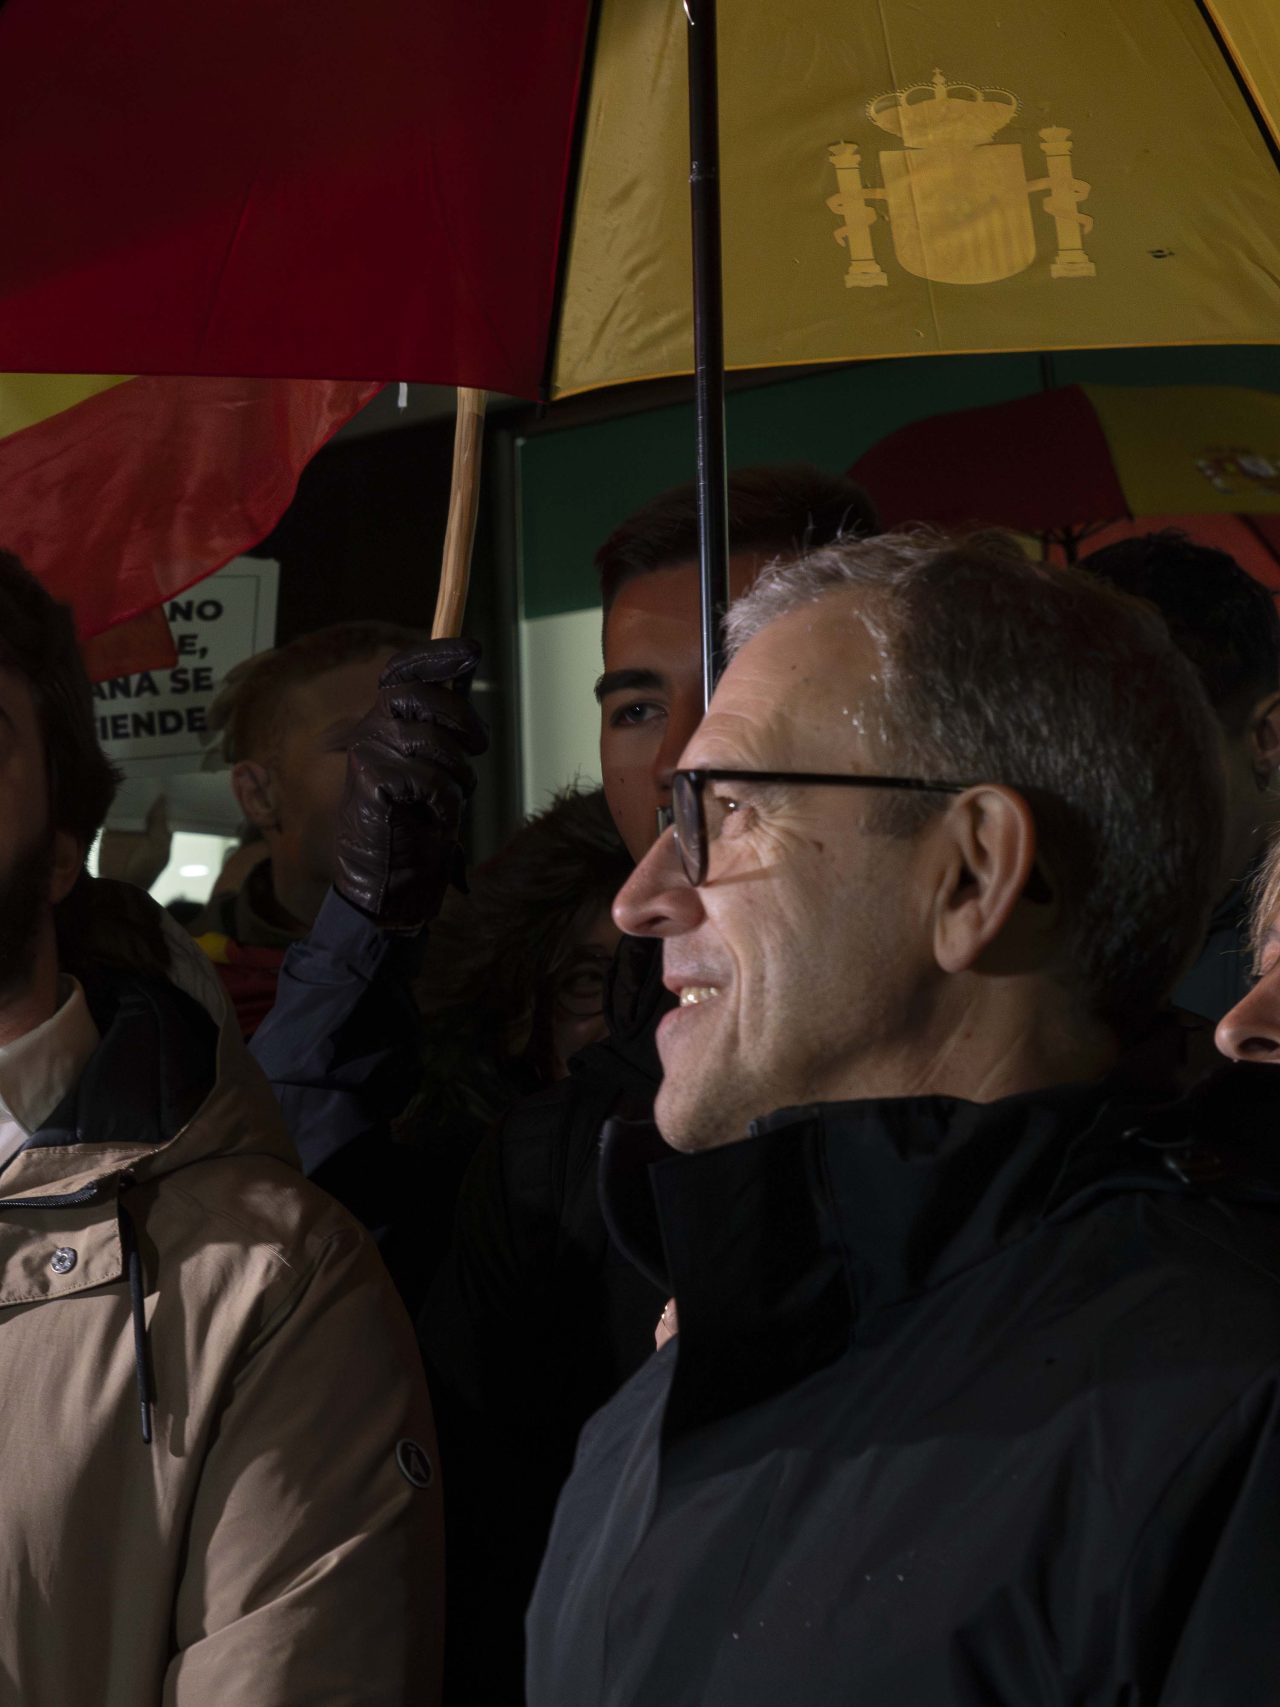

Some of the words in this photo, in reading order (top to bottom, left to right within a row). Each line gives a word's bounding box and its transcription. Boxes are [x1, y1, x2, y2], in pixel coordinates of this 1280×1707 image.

[168, 600, 224, 622] NO
[170, 667, 214, 695] SE
[98, 706, 208, 741] IENDE
